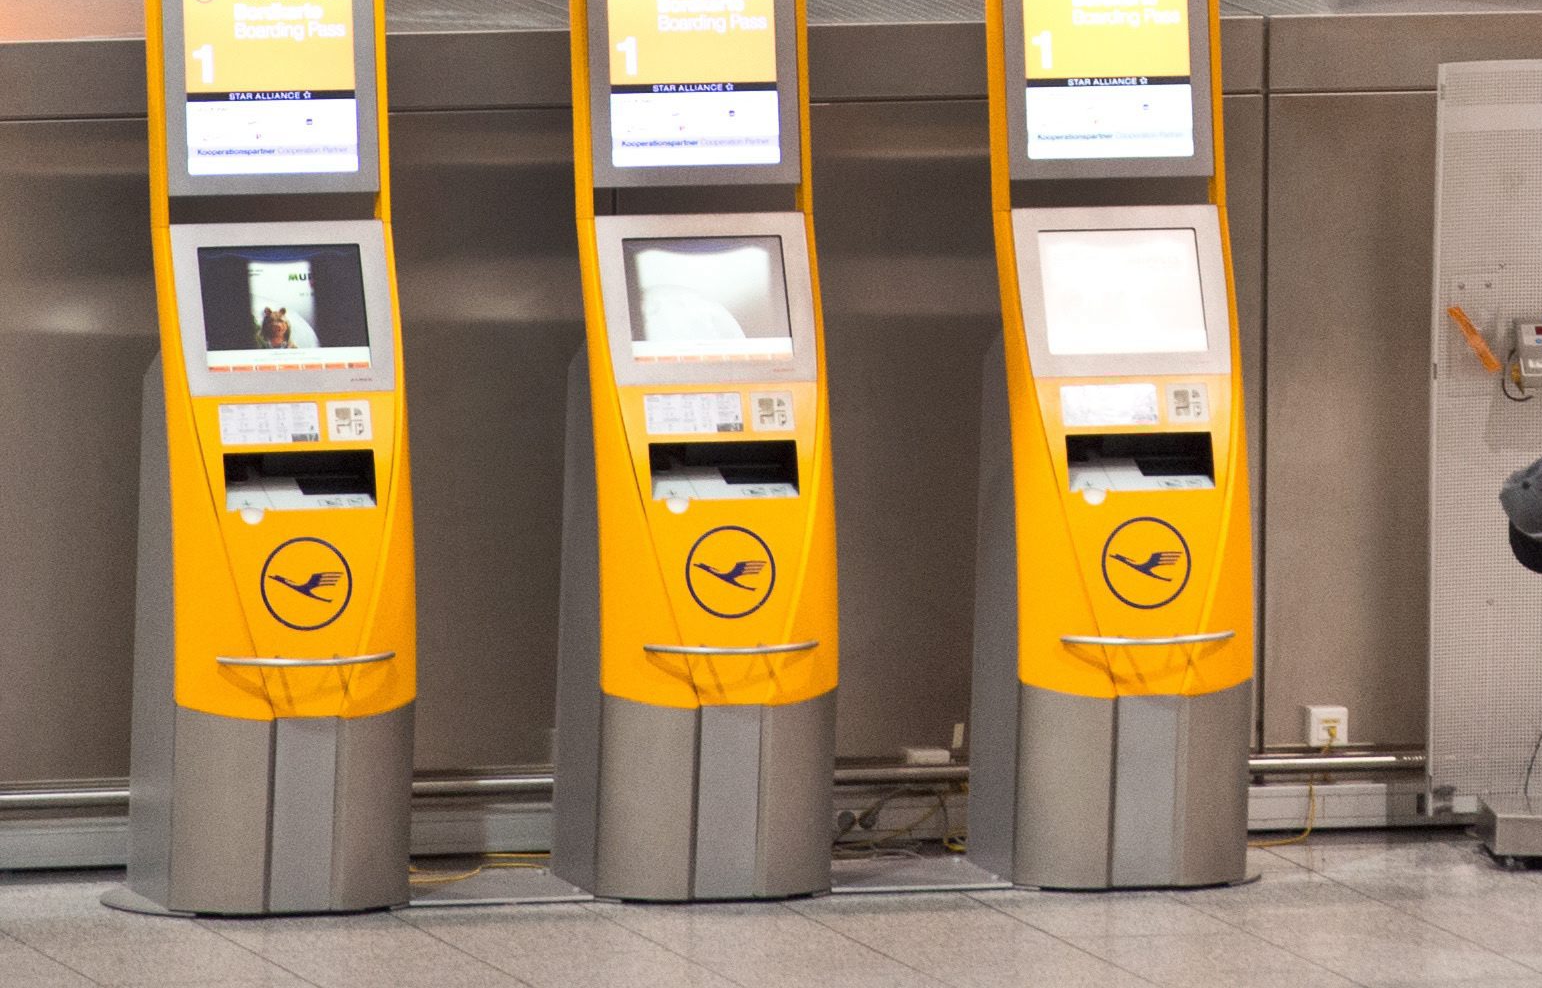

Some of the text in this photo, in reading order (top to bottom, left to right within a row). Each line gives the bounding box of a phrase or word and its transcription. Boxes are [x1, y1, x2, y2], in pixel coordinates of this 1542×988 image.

[234, 20, 346, 42] Boarding Pass
[657, 12, 768, 34] Boarding Pass
[616, 35, 639, 76] 1
[1031, 30, 1053, 69] 1
[191, 43, 215, 85] 1
[652, 83, 723, 93] STAR ALLIANCE
[1067, 77, 1138, 86] STAR ALLIANCE
[229, 91, 301, 101] STAR ALLIANCE
[197, 147, 275, 157] Kooperationspartner
